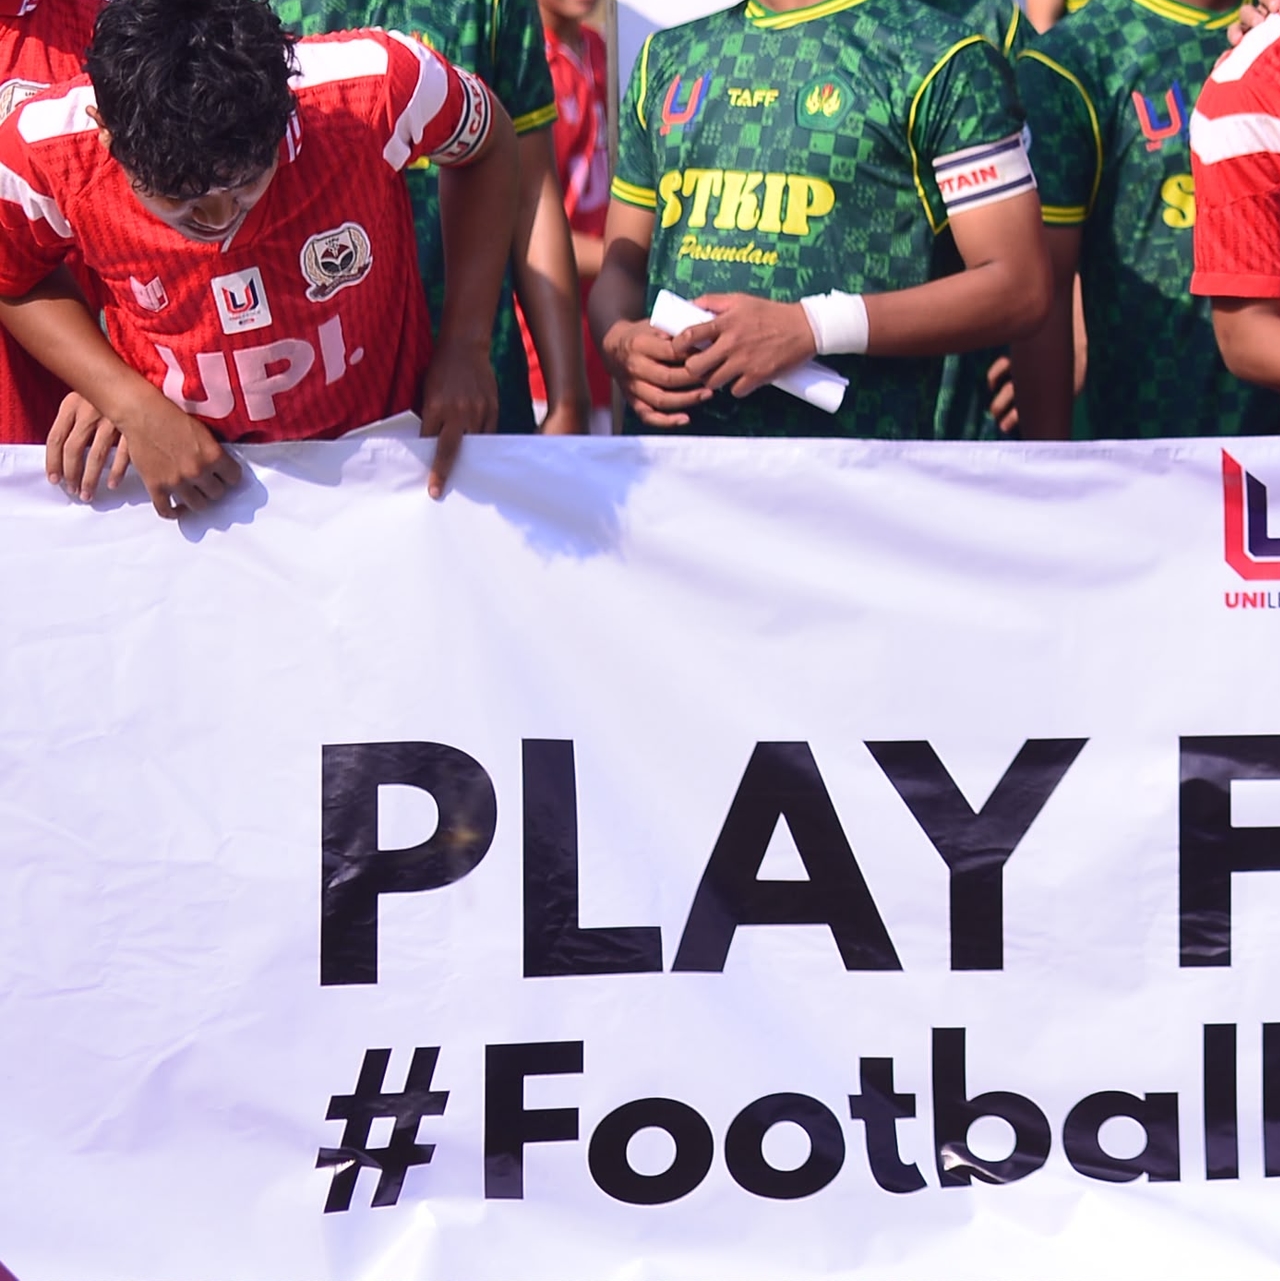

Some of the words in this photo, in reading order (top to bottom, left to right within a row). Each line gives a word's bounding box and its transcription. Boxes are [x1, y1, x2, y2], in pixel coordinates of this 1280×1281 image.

[727, 87, 780, 108] TAFF
[936, 164, 999, 195] TAIN
[658, 167, 837, 237] STKIP
[677, 234, 780, 267] Pasundan
[319, 735, 1091, 987] PLAY
